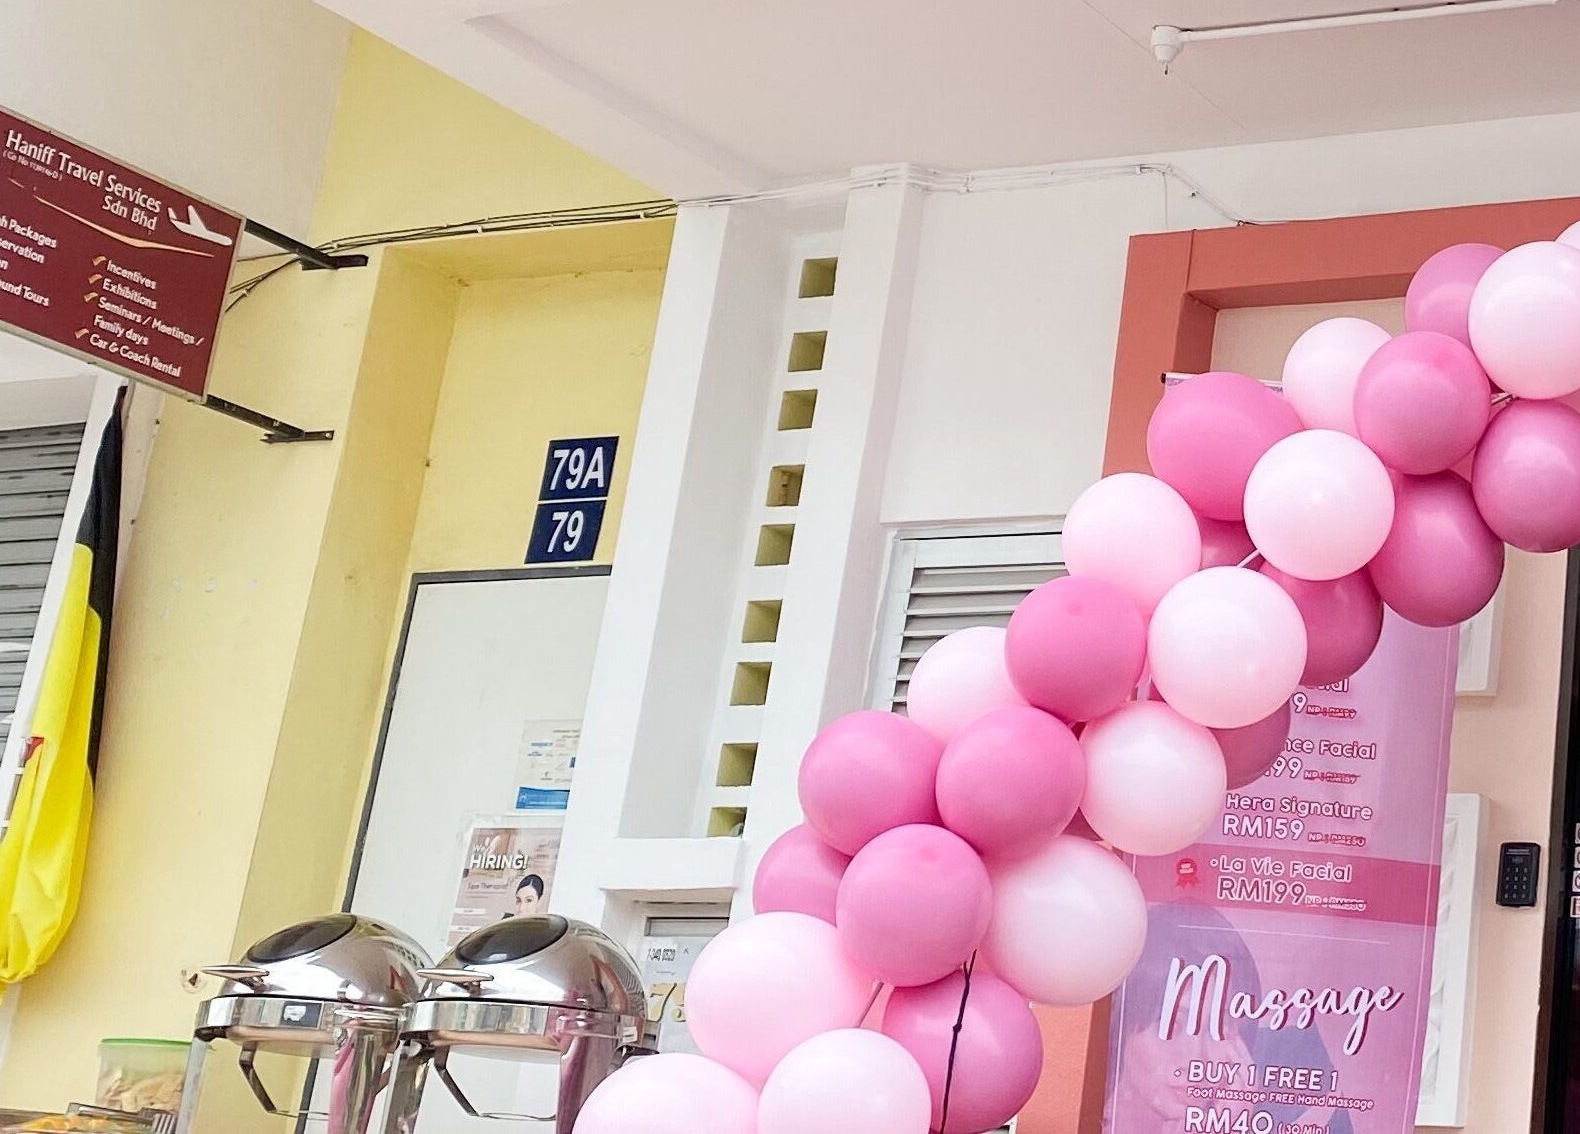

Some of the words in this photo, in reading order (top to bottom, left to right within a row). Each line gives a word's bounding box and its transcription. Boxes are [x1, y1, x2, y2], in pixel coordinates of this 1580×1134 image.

[6, 130, 56, 165] Haniff
[58, 152, 103, 187] Travel
[105, 174, 161, 213] Services
[102, 195, 128, 218] Sdn
[131, 207, 158, 231] Bhd
[9, 219, 57, 248] Packages
[107, 260, 156, 289] Incentives
[22, 286, 49, 306] Tours
[103, 278, 157, 309] Exhibitions
[94, 315, 125, 337] Family
[126, 328, 149, 345] days
[98, 297, 142, 323] Seminars
[152, 318, 195, 344] Meetings
[90, 334, 108, 349] Car
[109, 341, 119, 353] &
[120, 345, 151, 366] Coach
[151, 357, 181, 377] Rental
[550, 447, 604, 490] 79A
[547, 510, 584, 553] 79
[1285, 738, 1314, 754] nce
[1319, 740, 1376, 760] Facial
[1225, 793, 1275, 812] Hera
[1280, 796, 1373, 820] Signature
[1222, 813, 1305, 841] RM159
[469, 854, 529, 870] HIRING!
[1219, 854, 1246, 874] La
[1251, 857, 1284, 875] Vie
[1289, 860, 1352, 883] Facial
[1217, 875, 1307, 905] RM199
[1158, 954, 1405, 1056] Massage
[1187, 1060, 1241, 1084] BUY
[1247, 1064, 1257, 1086] 1
[1262, 1065, 1324, 1091] FREE
[1330, 1070, 1339, 1092] 1
[1187, 1086, 1214, 1099] Foot
[1215, 1089, 1267, 1103] Massage
[1268, 1092, 1296, 1105] FREE
[1297, 1094, 1326, 1106] Hand
[1327, 1096, 1374, 1112] Massage
[1185, 1105, 1275, 1134] RM40
